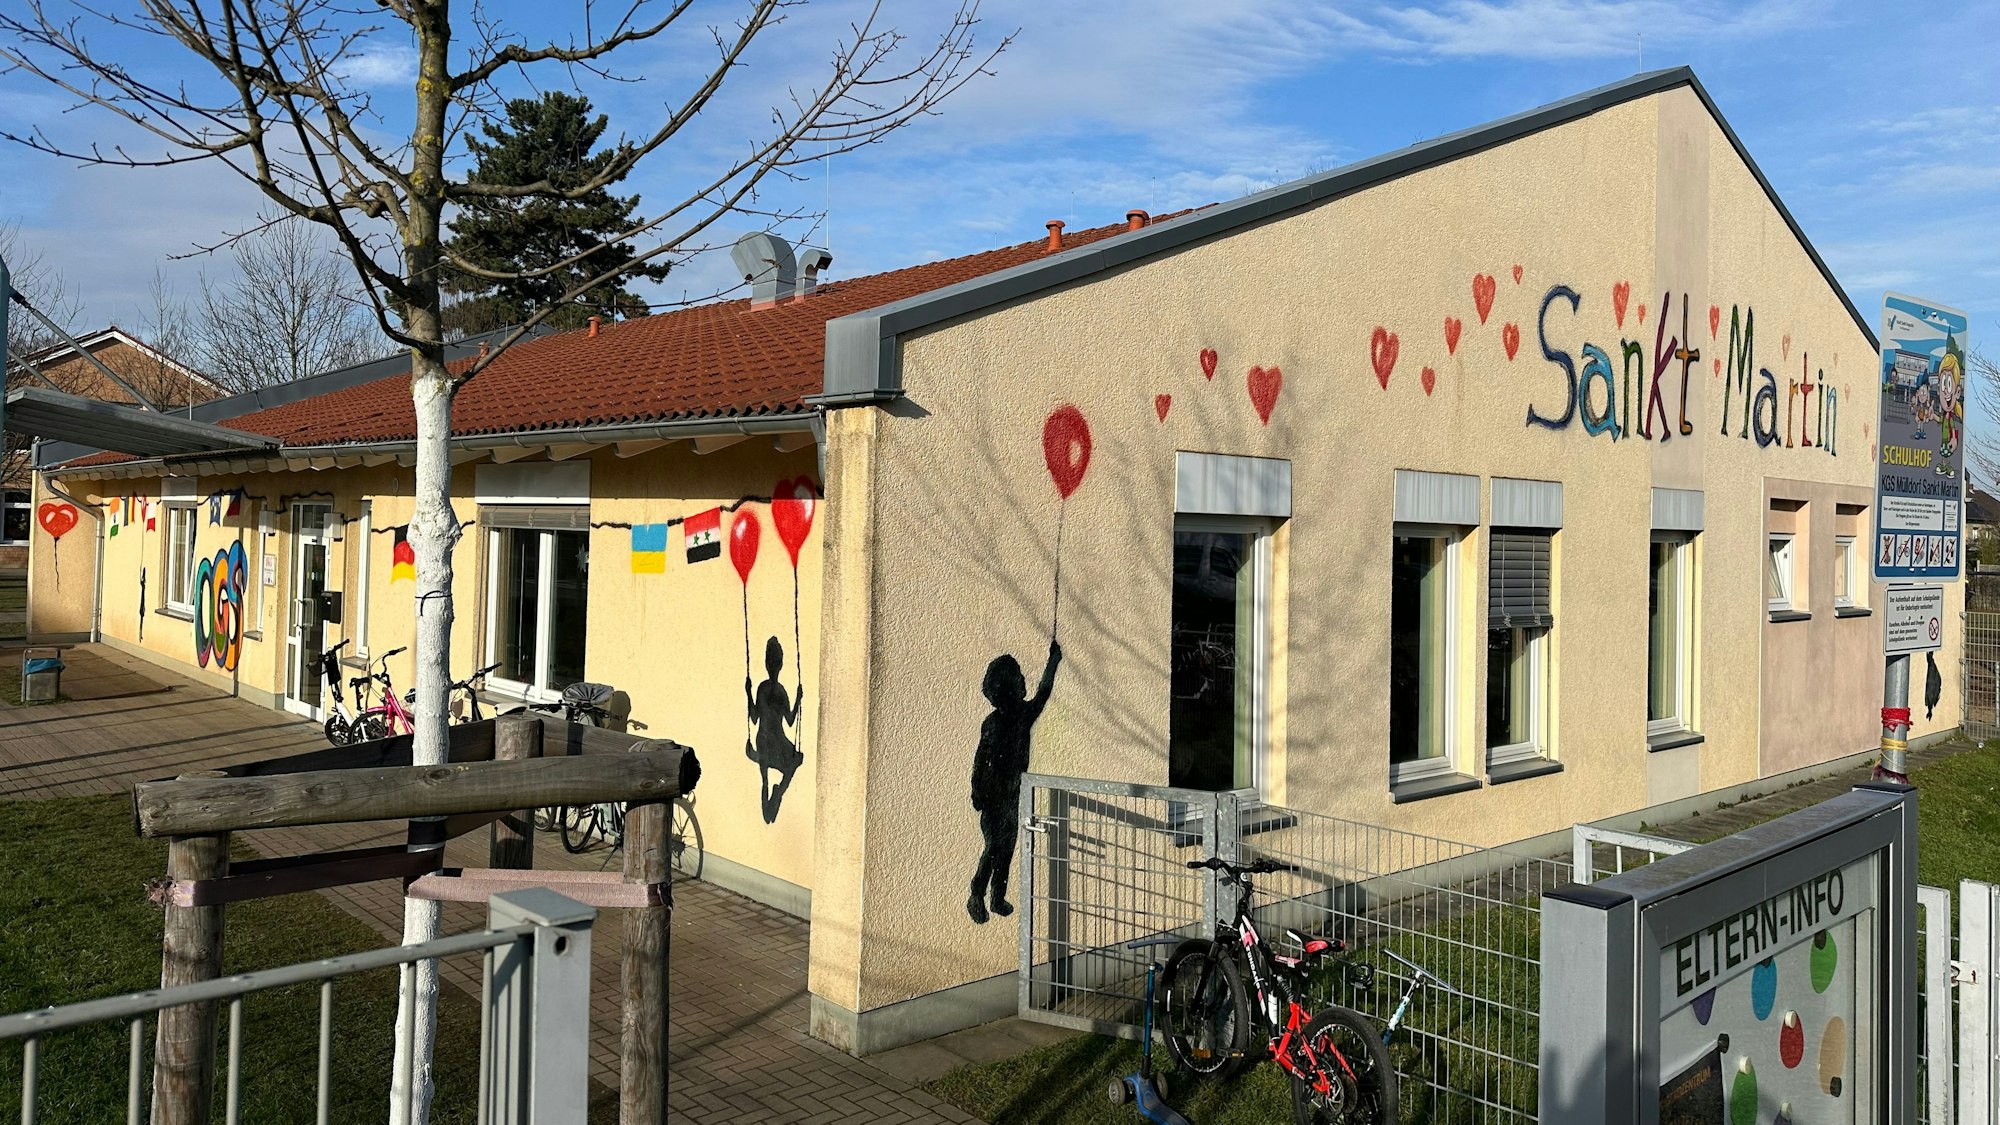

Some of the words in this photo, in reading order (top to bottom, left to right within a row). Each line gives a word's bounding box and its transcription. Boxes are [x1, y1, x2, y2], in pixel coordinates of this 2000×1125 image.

[1526, 285, 1700, 443] Sankt
[1721, 303, 1837, 457] Martin
[1881, 474, 1896, 492] KGS
[1896, 475, 1922, 495] Mülldorf
[1922, 478, 1940, 497] Sankt
[1940, 481, 1959, 498] Martin
[1882, 444, 1932, 468] SCHULHOF
[195, 539, 248, 672] OGS
[1675, 867, 1844, 998] ELTERN-INFO
